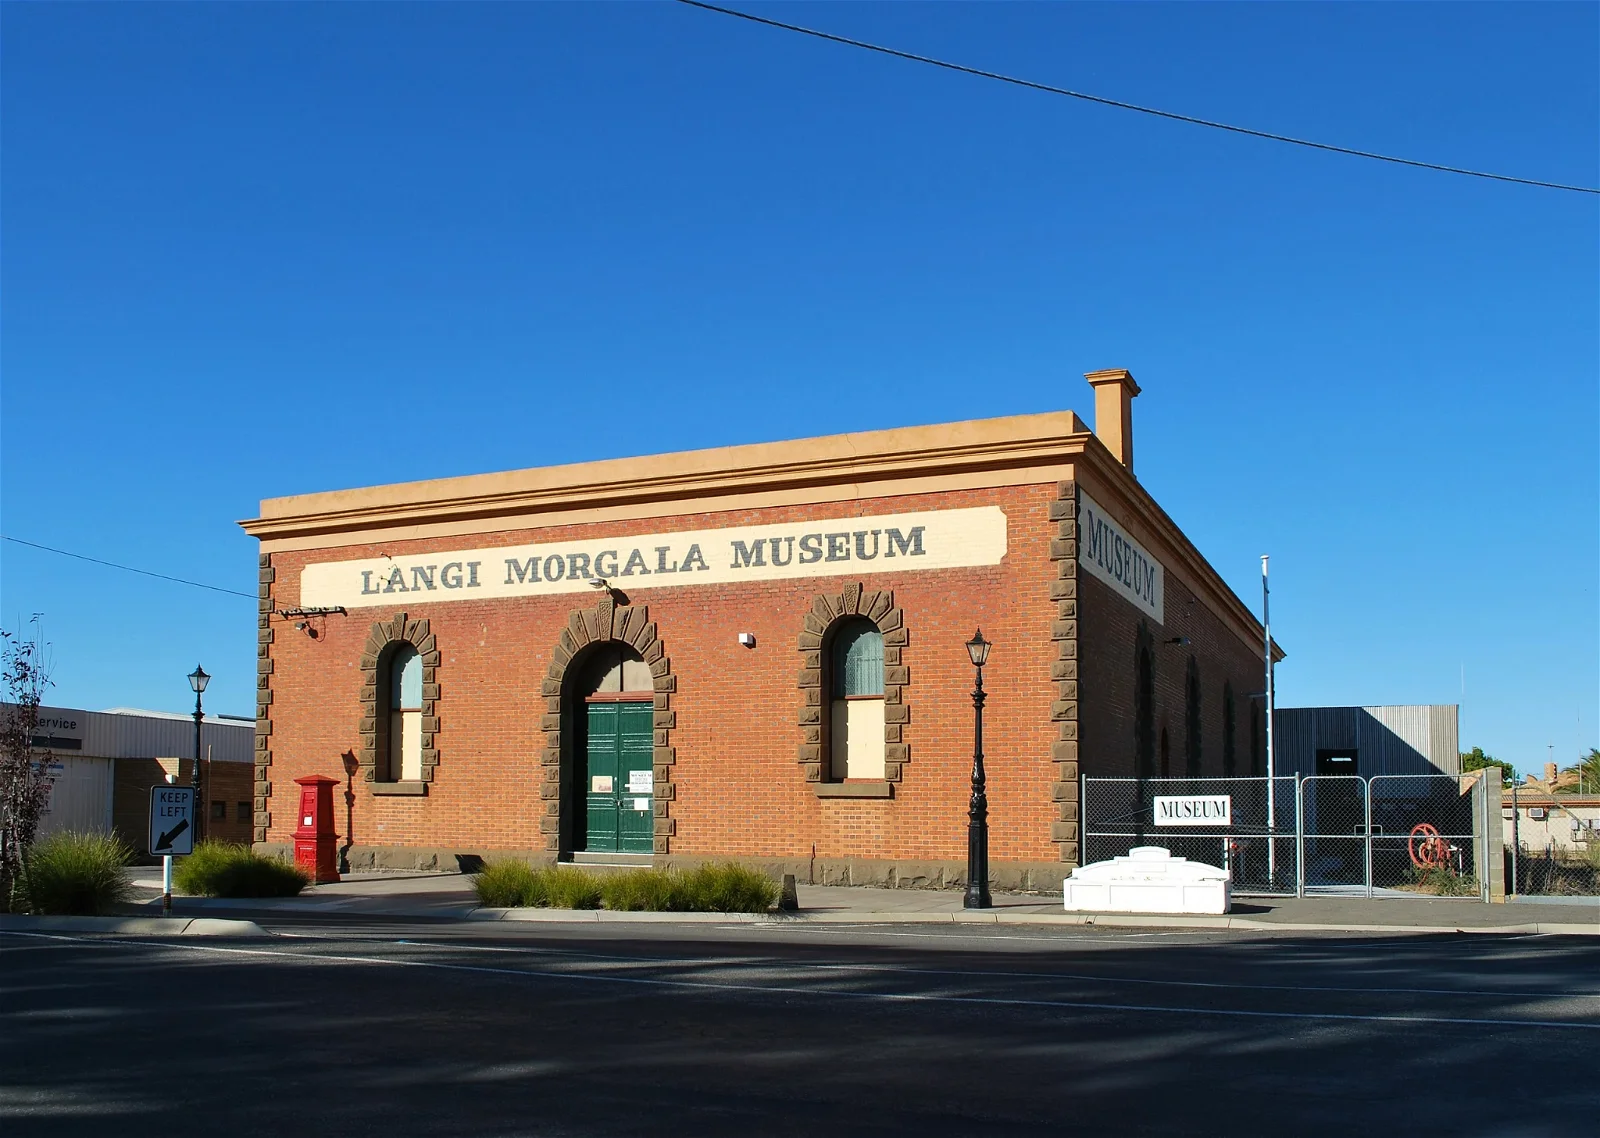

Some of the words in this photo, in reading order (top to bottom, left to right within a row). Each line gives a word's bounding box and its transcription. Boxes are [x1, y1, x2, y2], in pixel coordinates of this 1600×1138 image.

[361, 561, 481, 595] LANGI
[504, 543, 710, 584] MORGALA
[730, 526, 926, 569] MUSEUM
[1087, 509, 1155, 608] MUSEUM
[38, 717, 77, 729] ervice
[160, 792, 188, 803] KEEP
[160, 806, 187, 817] LEFT
[1160, 800, 1227, 818] MUSEUM
